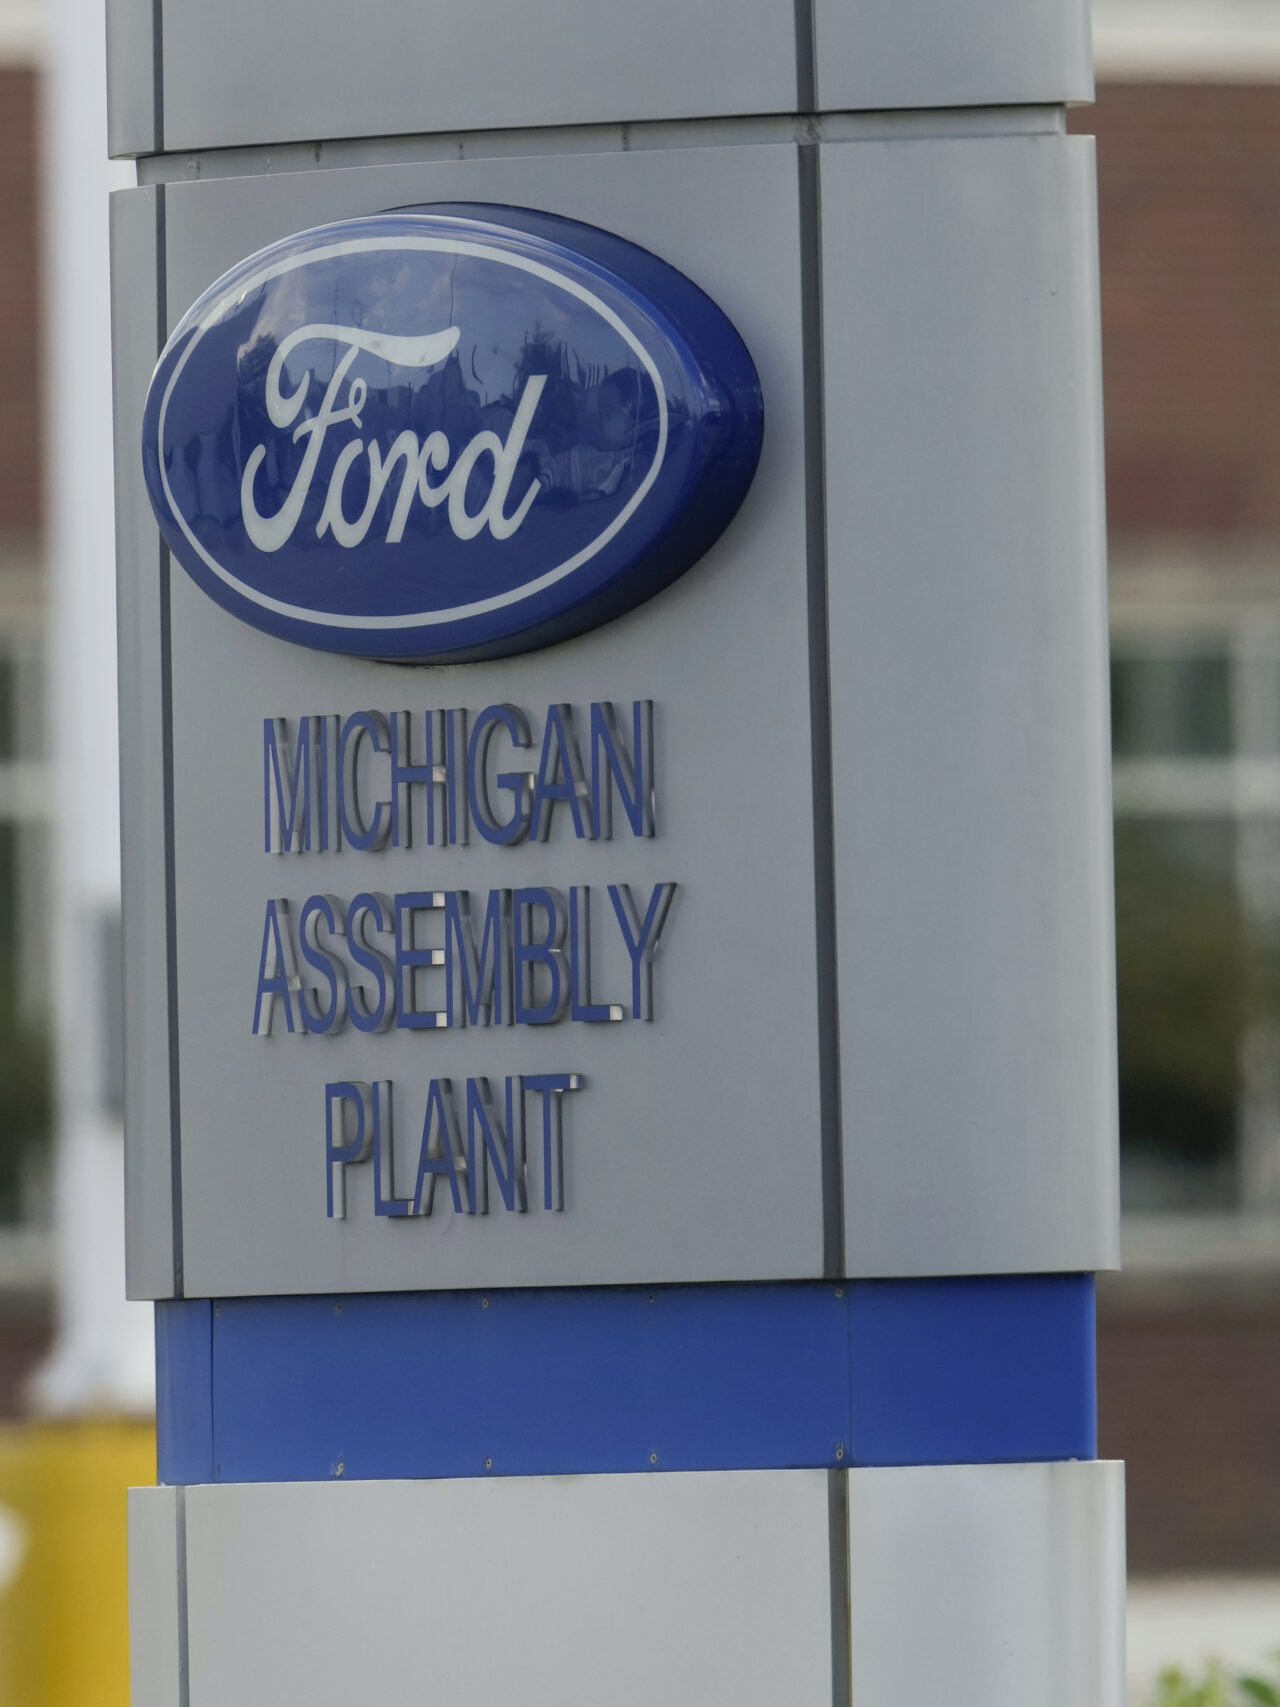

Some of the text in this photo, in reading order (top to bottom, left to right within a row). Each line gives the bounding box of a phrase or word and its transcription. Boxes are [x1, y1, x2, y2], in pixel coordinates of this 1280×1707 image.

[241, 323, 548, 552] Ford
[263, 699, 656, 853] MICHIGAN
[252, 882, 677, 1035] ASSEMBLY
[325, 1073, 584, 1218] PLANT
